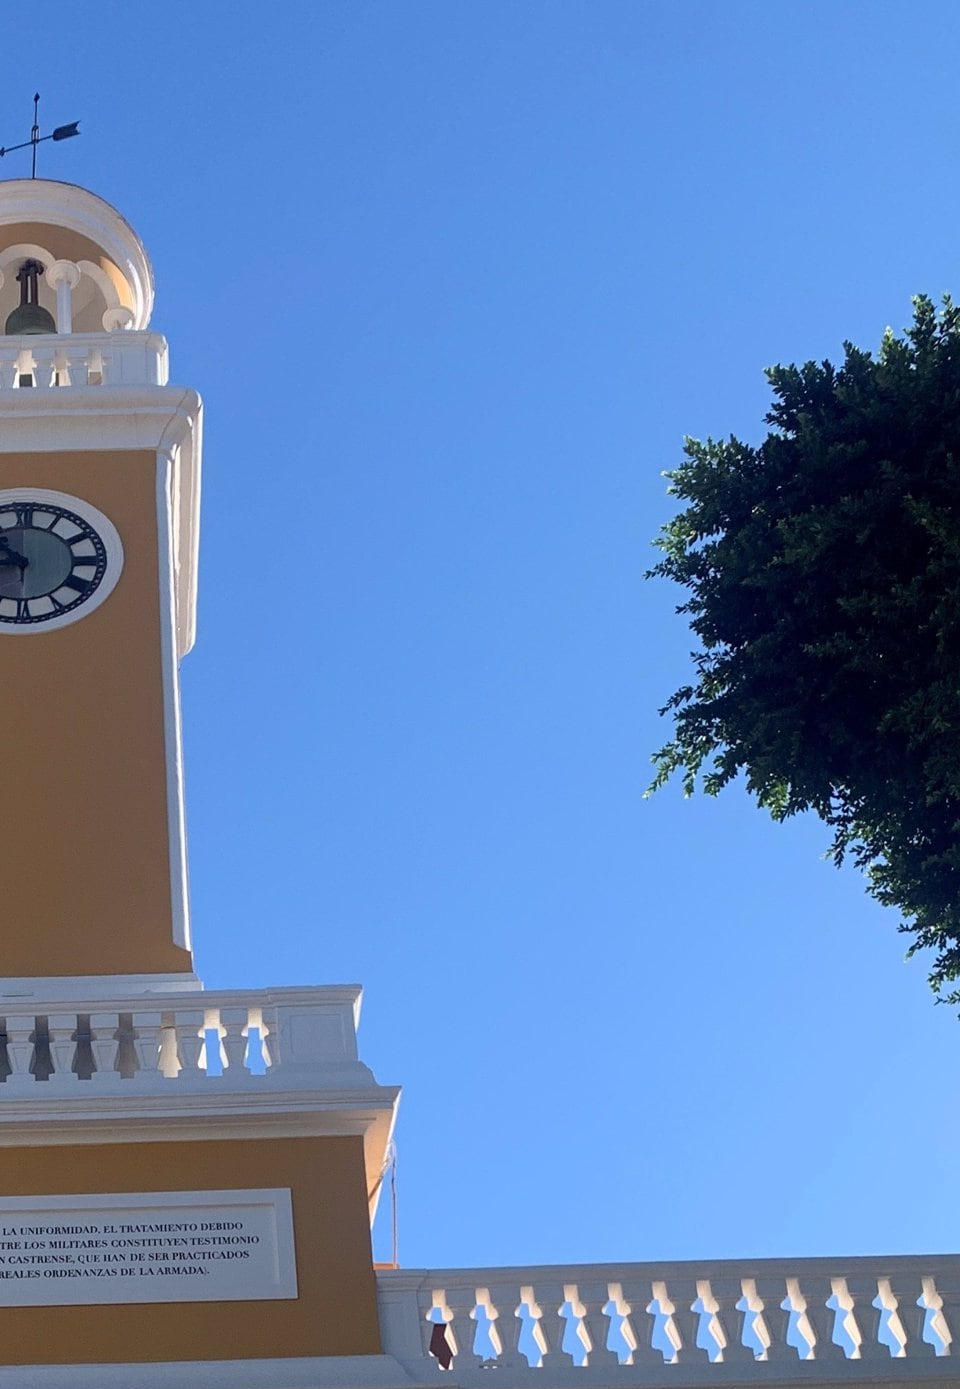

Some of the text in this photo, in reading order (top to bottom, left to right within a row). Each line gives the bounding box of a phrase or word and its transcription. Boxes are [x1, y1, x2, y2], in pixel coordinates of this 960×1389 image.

[2, 1227, 17, 1236] LA
[103, 1225, 118, 1234] EL
[119, 1223, 198, 1234] TRATAMIENTO
[200, 1222, 243, 1231] DEBIDO
[24, 1241, 46, 1250] LOS
[49, 1240, 108, 1249] MILITARES
[111, 1238, 188, 1248] CONSTITUYEN
[190, 1235, 260, 1246] TESTIMONIO
[8, 1254, 76, 1265] CASTRENSE,
[77, 1254, 100, 1265] QUE
[103, 1253, 126, 1262] HAN
[130, 1253, 146, 1262] DE
[148, 1252, 170, 1261] SER
[172, 1250, 250, 1260] PRACTICADOS
[43, 1268, 118, 1278] ORDENANZAS
[120, 1268, 136, 1276] DE
[139, 1267, 155, 1276] LA
